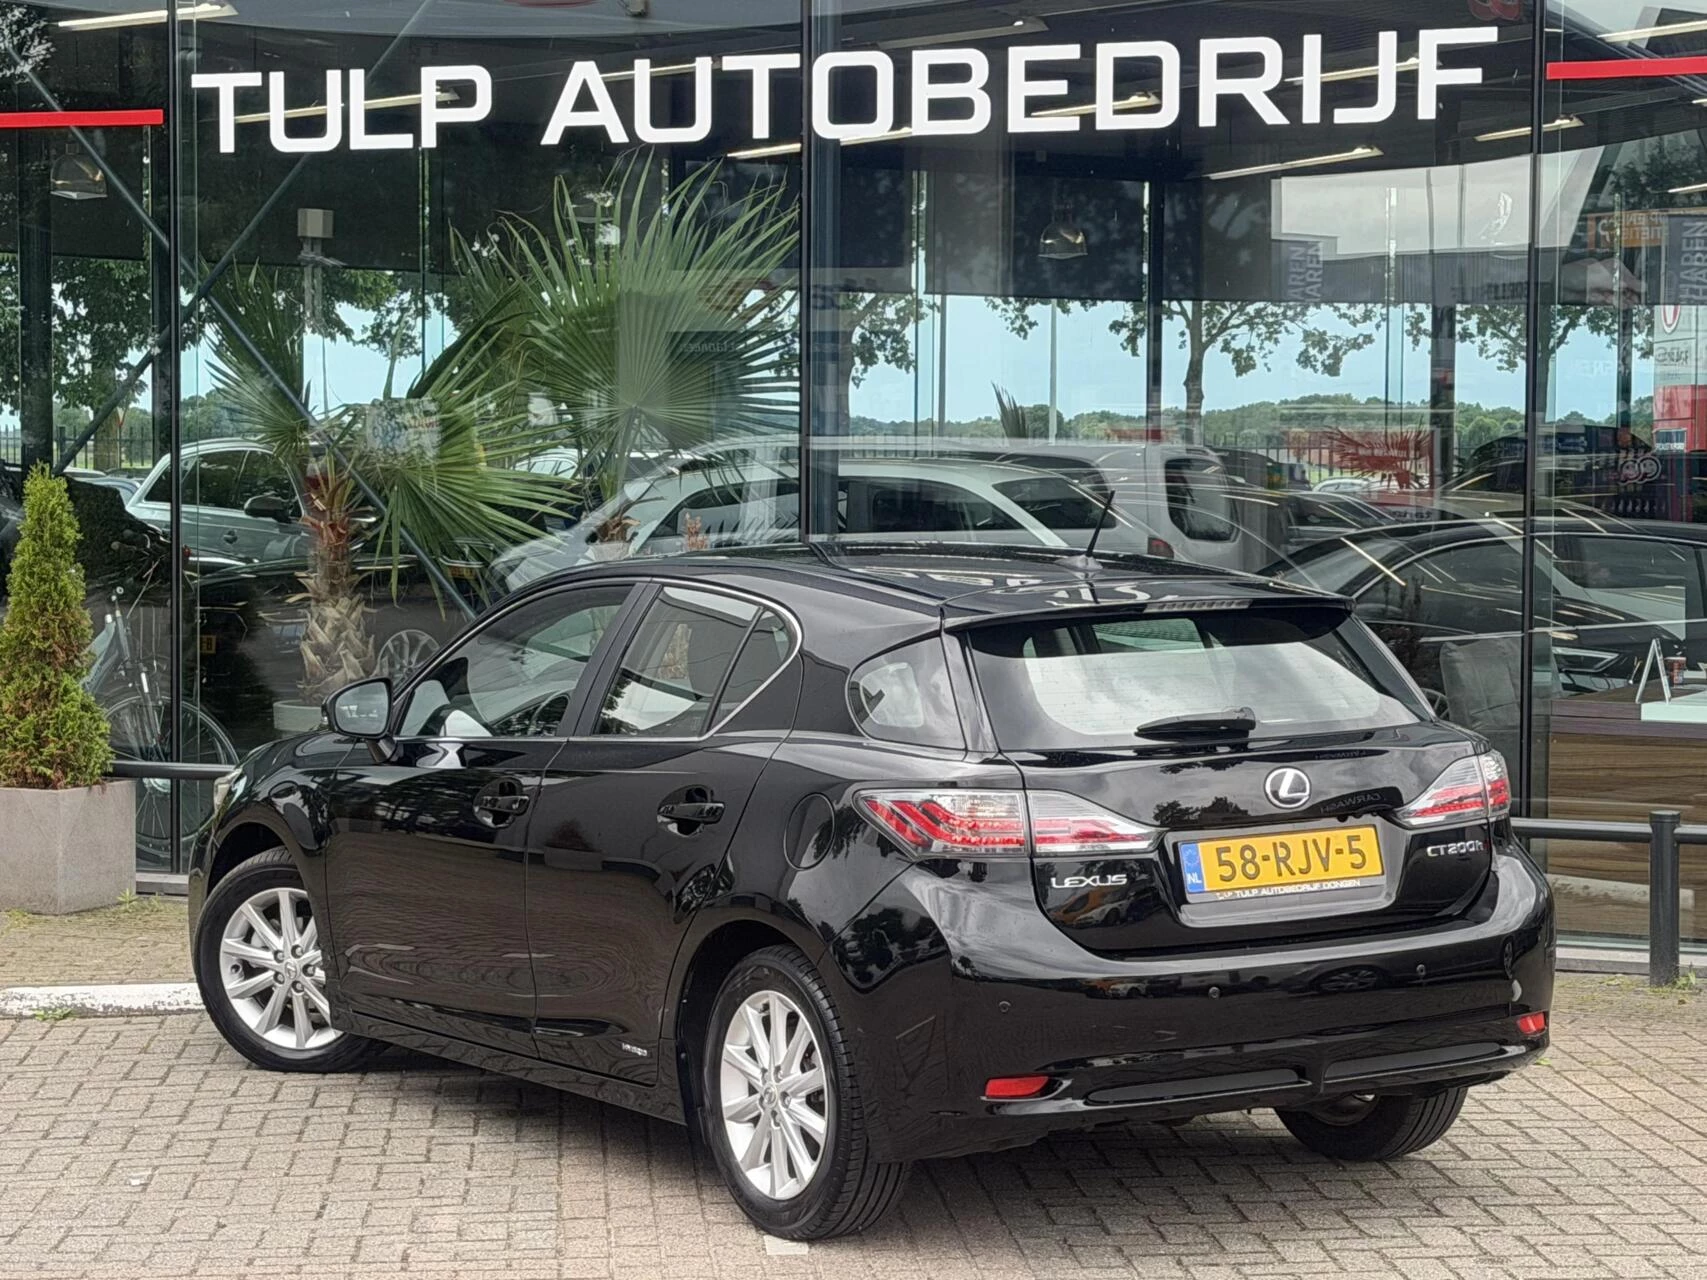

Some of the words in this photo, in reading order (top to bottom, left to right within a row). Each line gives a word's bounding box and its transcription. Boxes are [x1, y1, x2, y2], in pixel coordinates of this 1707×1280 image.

[191, 65, 492, 153] TULP
[540, 26, 1498, 145] AUTOBEDRIJF
[1215, 835, 1367, 882] 58-RJV-5
[1050, 874, 1128, 889] LEXUS
[1187, 873, 1202, 884] NL
[1236, 888, 1258, 898] TULP
